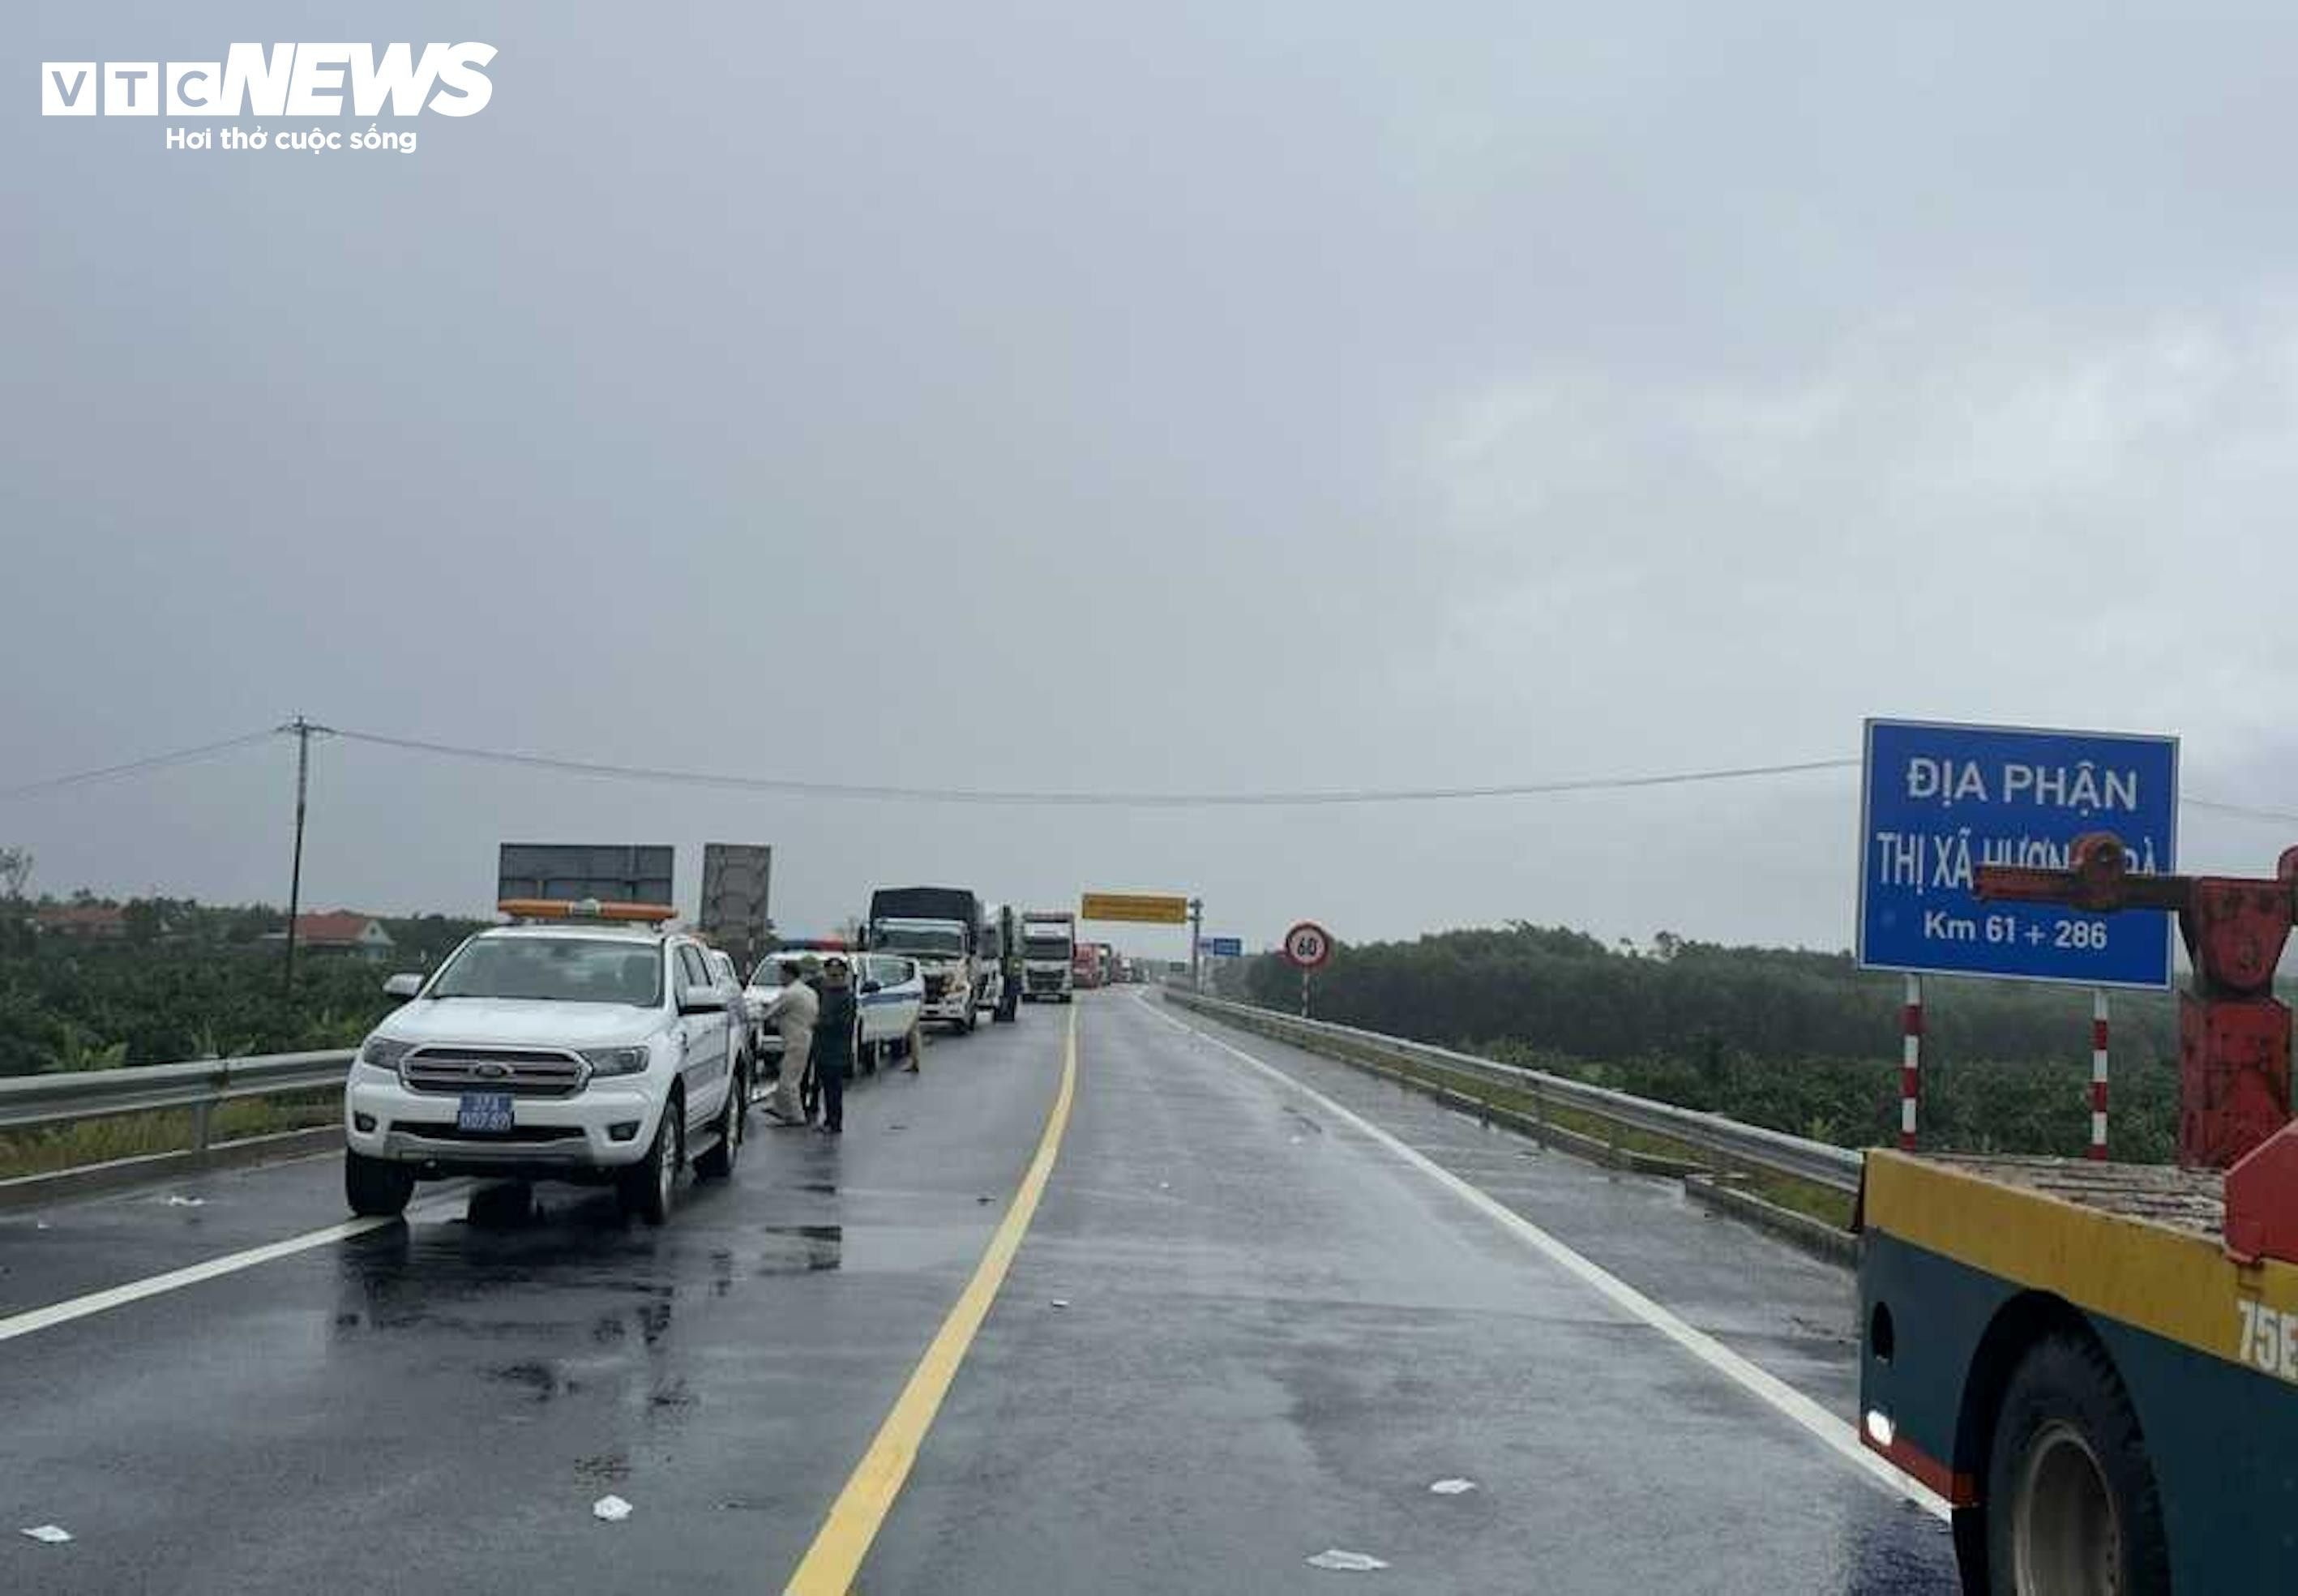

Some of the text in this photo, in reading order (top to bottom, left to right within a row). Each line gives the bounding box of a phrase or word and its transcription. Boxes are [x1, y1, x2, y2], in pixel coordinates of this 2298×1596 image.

[1907, 758, 2137, 816] ĐỊA PHẬN
[1876, 832, 1925, 895] THỊ
[1932, 827, 1974, 889] XÃ
[1983, 833, 2072, 870] HƯƠN
[1297, 936, 1318, 957] 60
[1924, 910, 2108, 950] Km 61 + 286
